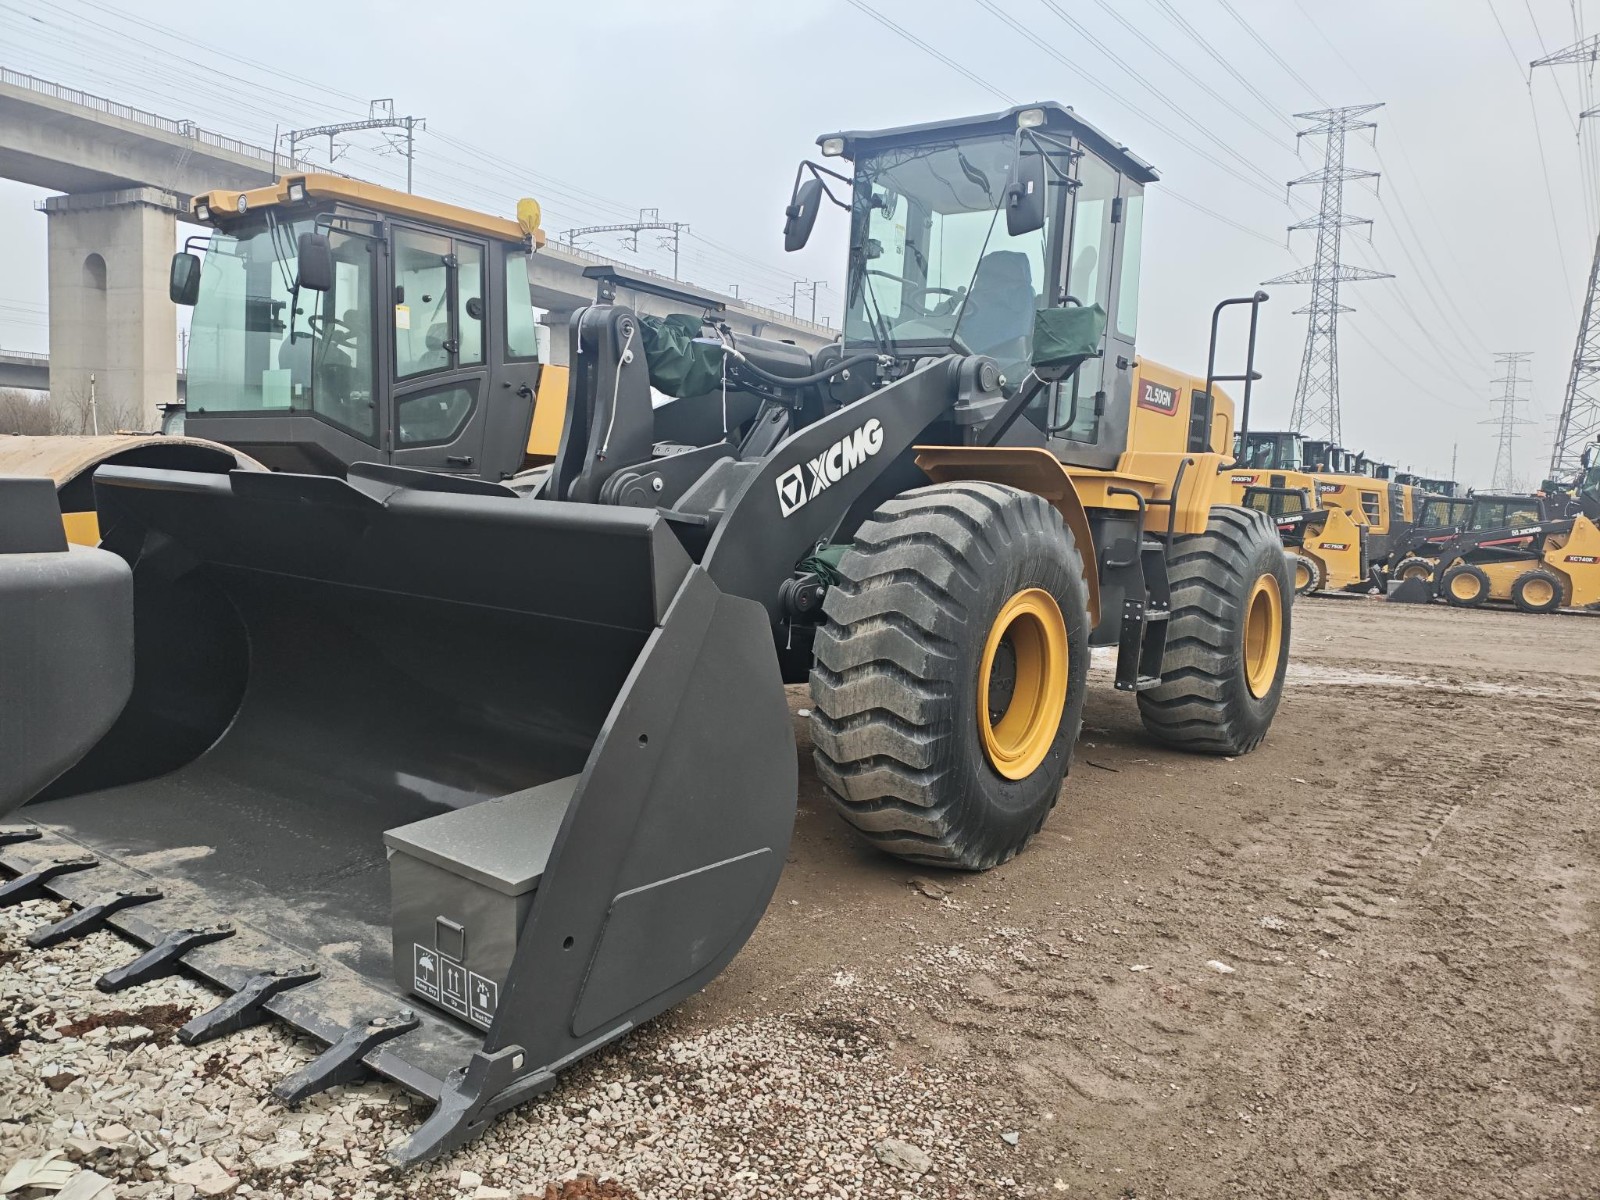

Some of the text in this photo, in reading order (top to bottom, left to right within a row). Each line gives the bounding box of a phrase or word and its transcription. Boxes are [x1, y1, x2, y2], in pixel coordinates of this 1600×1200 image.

[1144, 384, 1172, 407] ZL50GN
[806, 418, 884, 502] XCMG
[1520, 526, 1542, 535] XCMG
[1569, 555, 1594, 563] XC740K
[416, 980, 437, 997] Keep Dry
